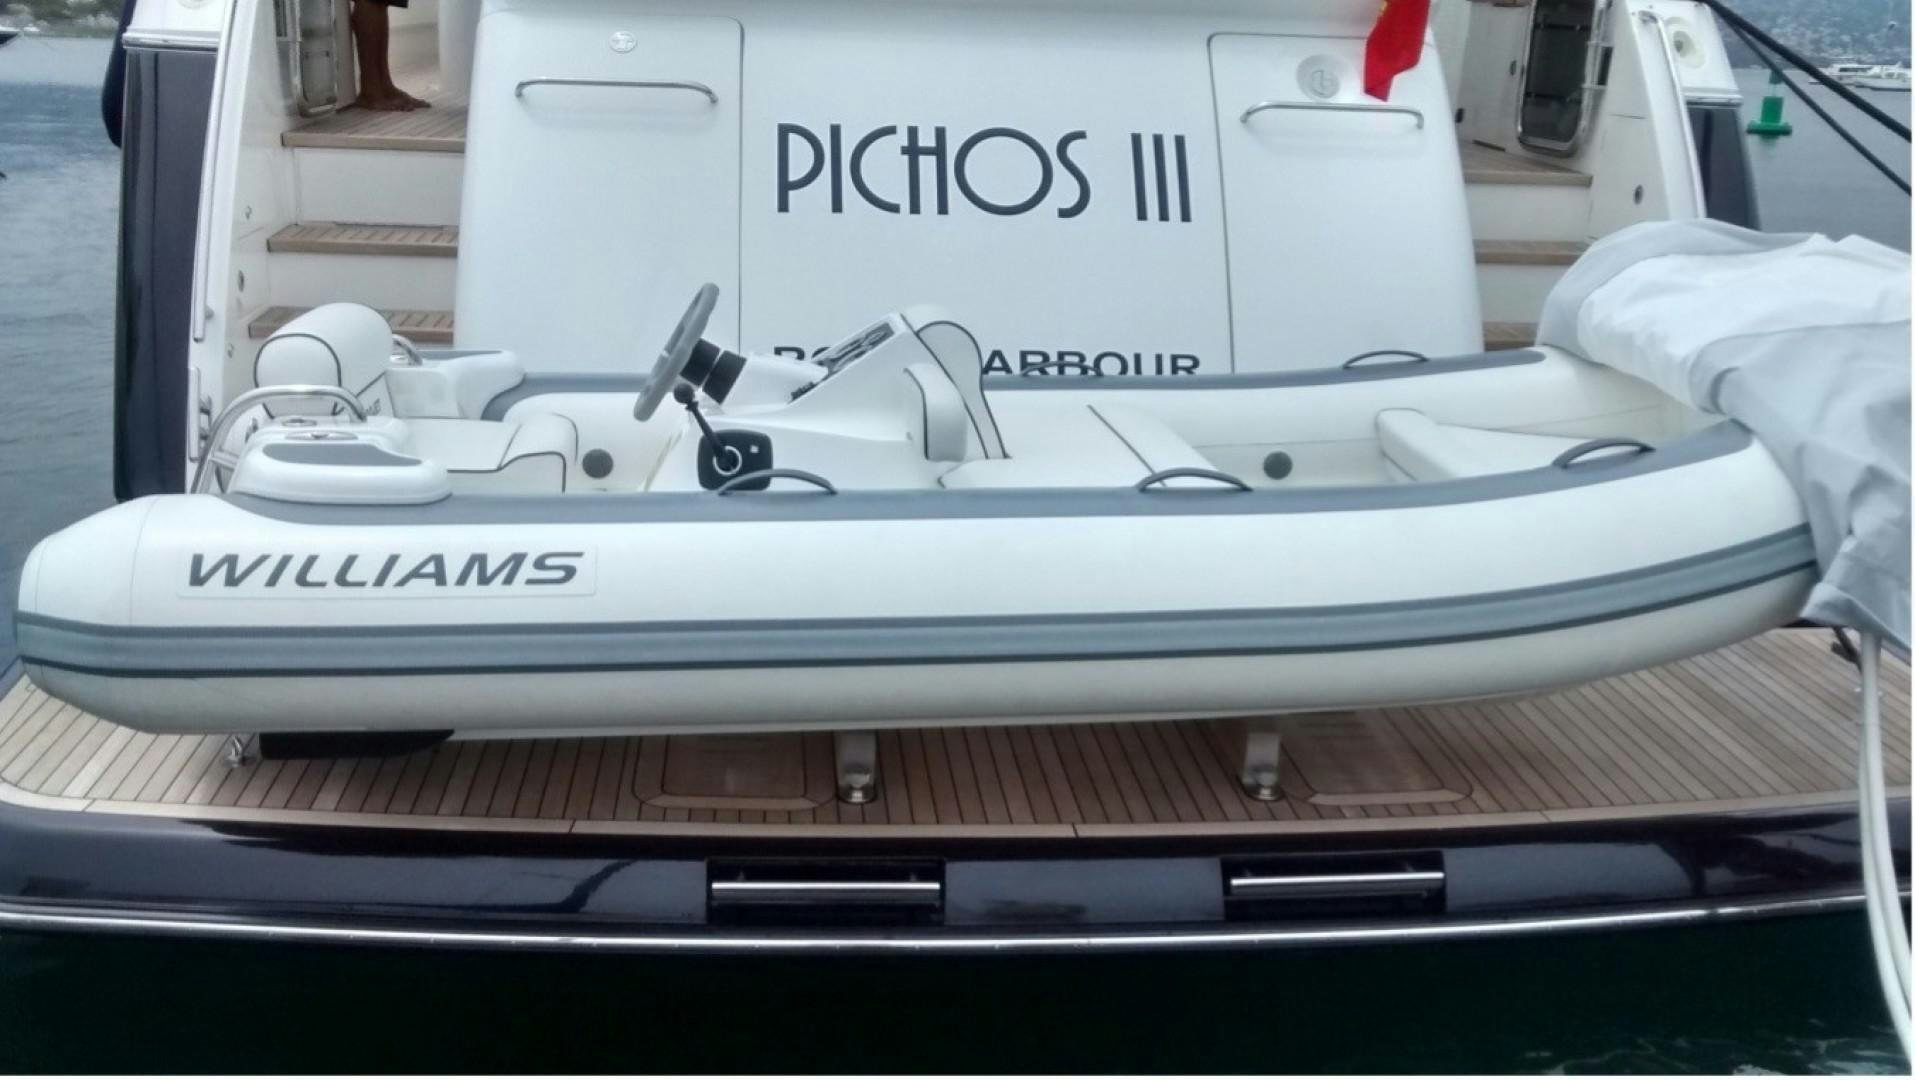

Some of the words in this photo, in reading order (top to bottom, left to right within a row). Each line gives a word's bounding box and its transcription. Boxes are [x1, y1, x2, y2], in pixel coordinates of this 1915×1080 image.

[777, 122, 1091, 219] PICHOS
[1131, 132, 1192, 223] III
[981, 349, 1201, 376] ARBOUR
[187, 551, 585, 588] WILLIAMS
